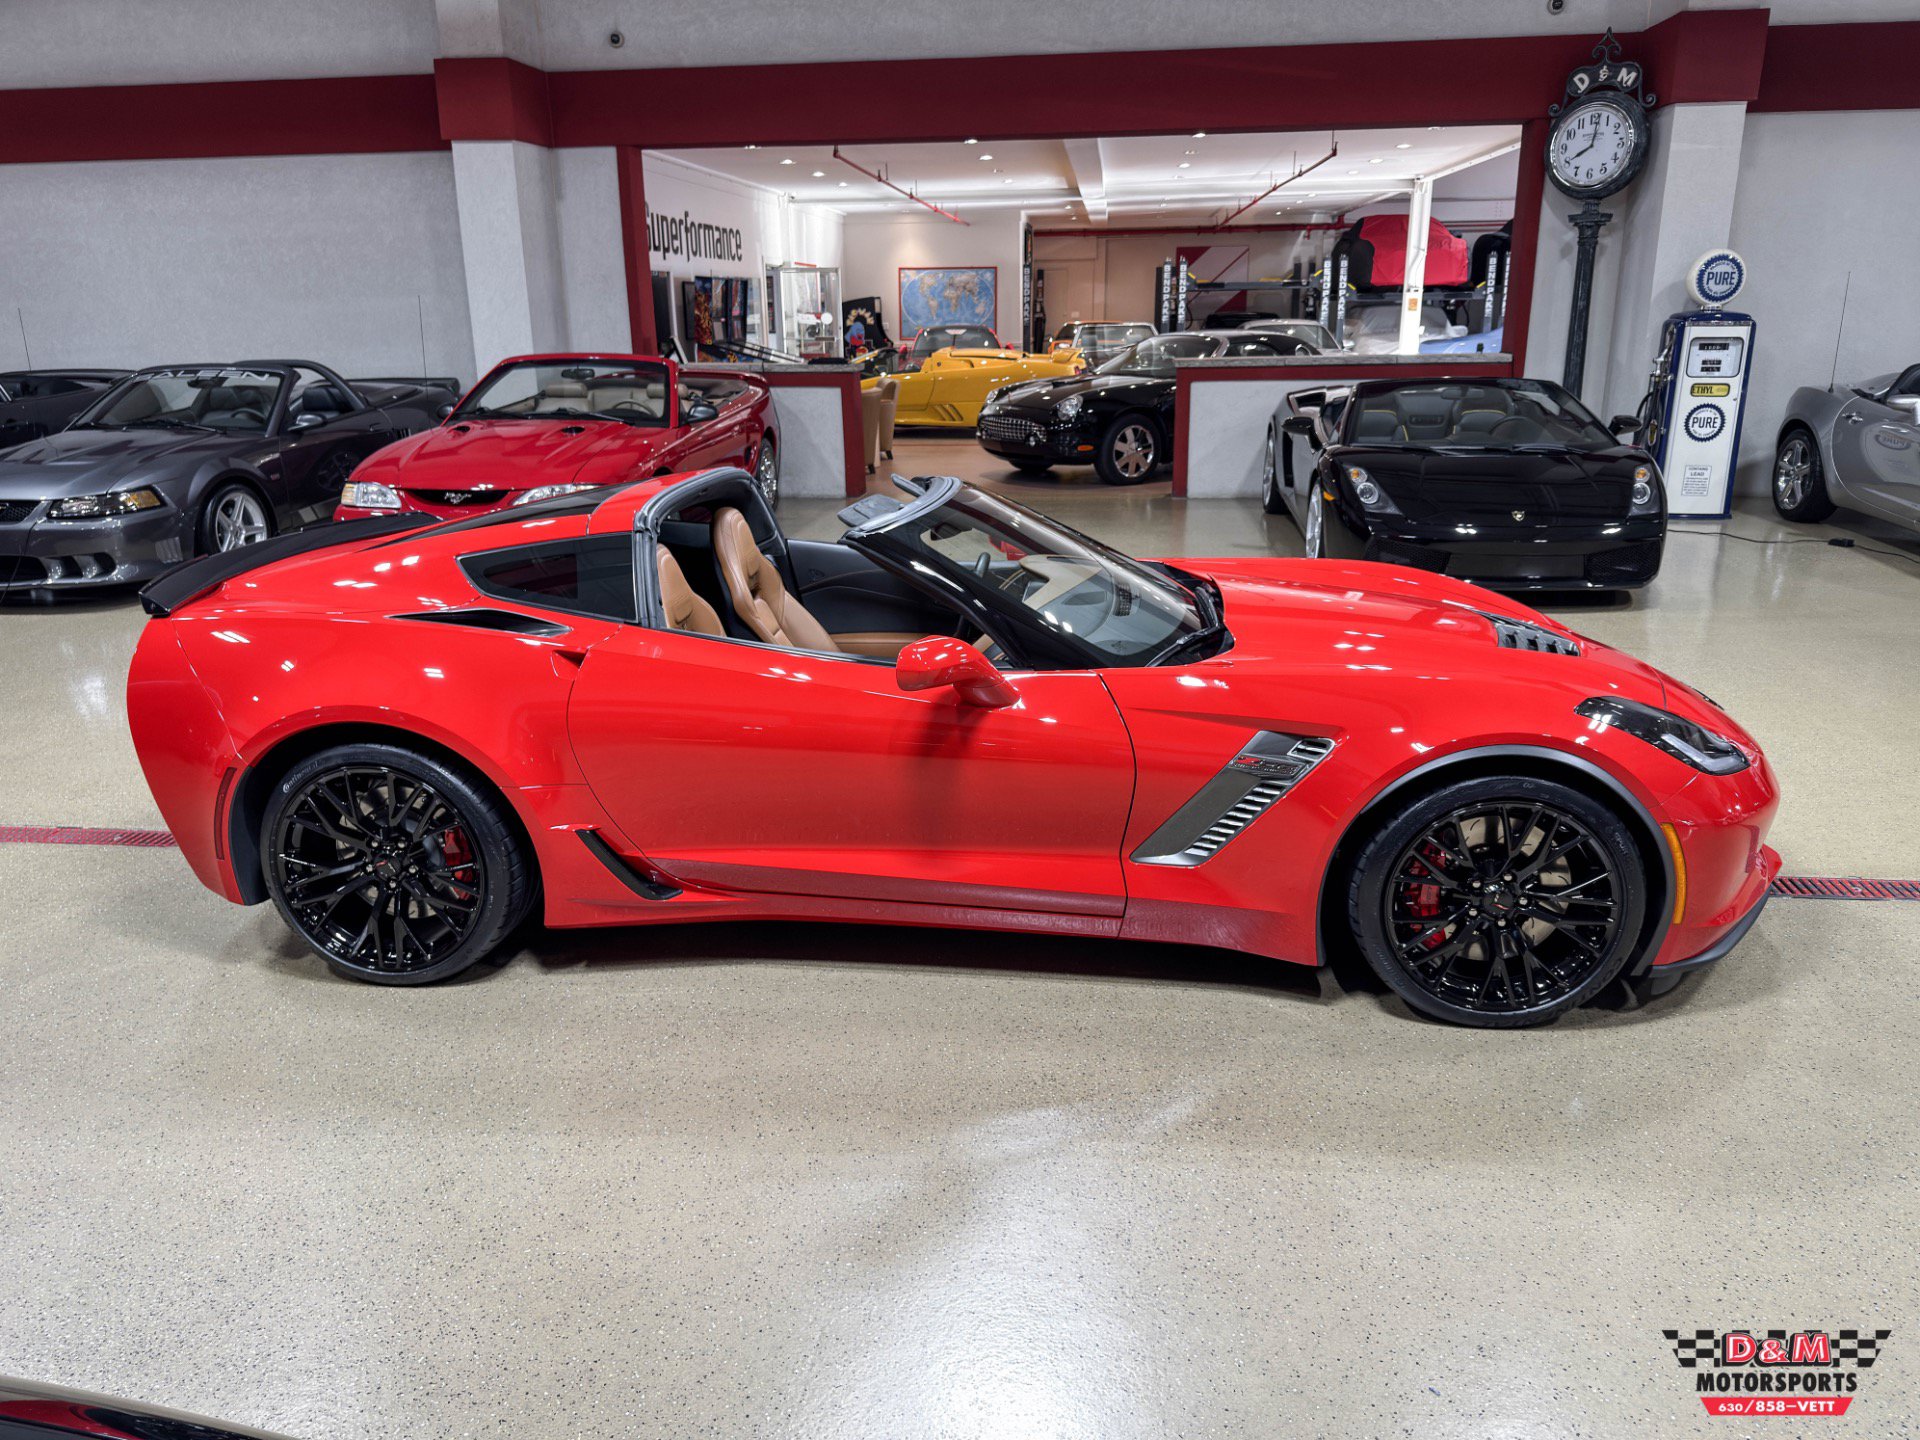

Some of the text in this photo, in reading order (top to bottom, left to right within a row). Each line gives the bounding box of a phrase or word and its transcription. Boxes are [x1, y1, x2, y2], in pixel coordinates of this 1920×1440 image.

[1573, 72, 1590, 93] D
[1617, 67, 1638, 88] M
[1577, 117, 1585, 129] 11
[1605, 114, 1610, 127] 1
[1566, 128, 1576, 141] 10
[1613, 122, 1621, 135] 2
[1560, 143, 1568, 155] 9
[1616, 137, 1625, 149] 3
[1563, 156, 1571, 169] 8
[1611, 151, 1619, 163] 4
[1573, 166, 1580, 177] 7
[1586, 167, 1593, 179] 6
[1599, 162, 1607, 174] 5
[1706, 271, 1737, 286] PURE
[1692, 386, 1714, 395] ETHYL
[1691, 416, 1719, 429] PURE
